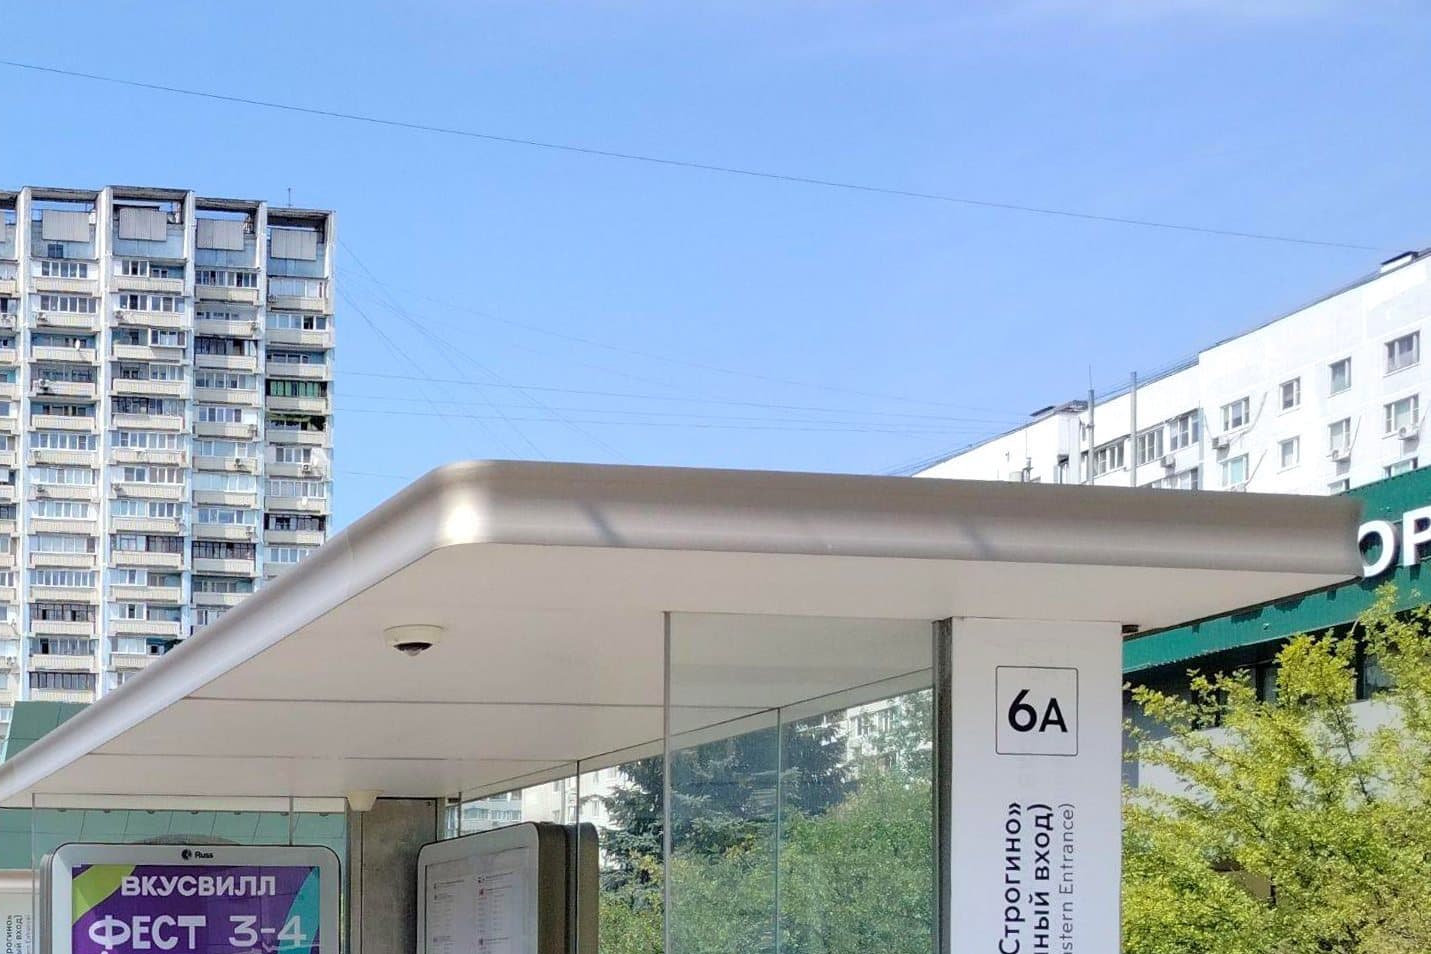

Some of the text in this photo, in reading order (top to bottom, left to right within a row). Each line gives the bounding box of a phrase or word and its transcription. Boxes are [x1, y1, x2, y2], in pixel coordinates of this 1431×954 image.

[1027, 804, 1053, 880] вход)
[1058, 803, 1075, 894] Entrance)
[121, 875, 276, 896] ВКУСВИЛЛ
[88, 915, 206, 950] ФЕСТ
